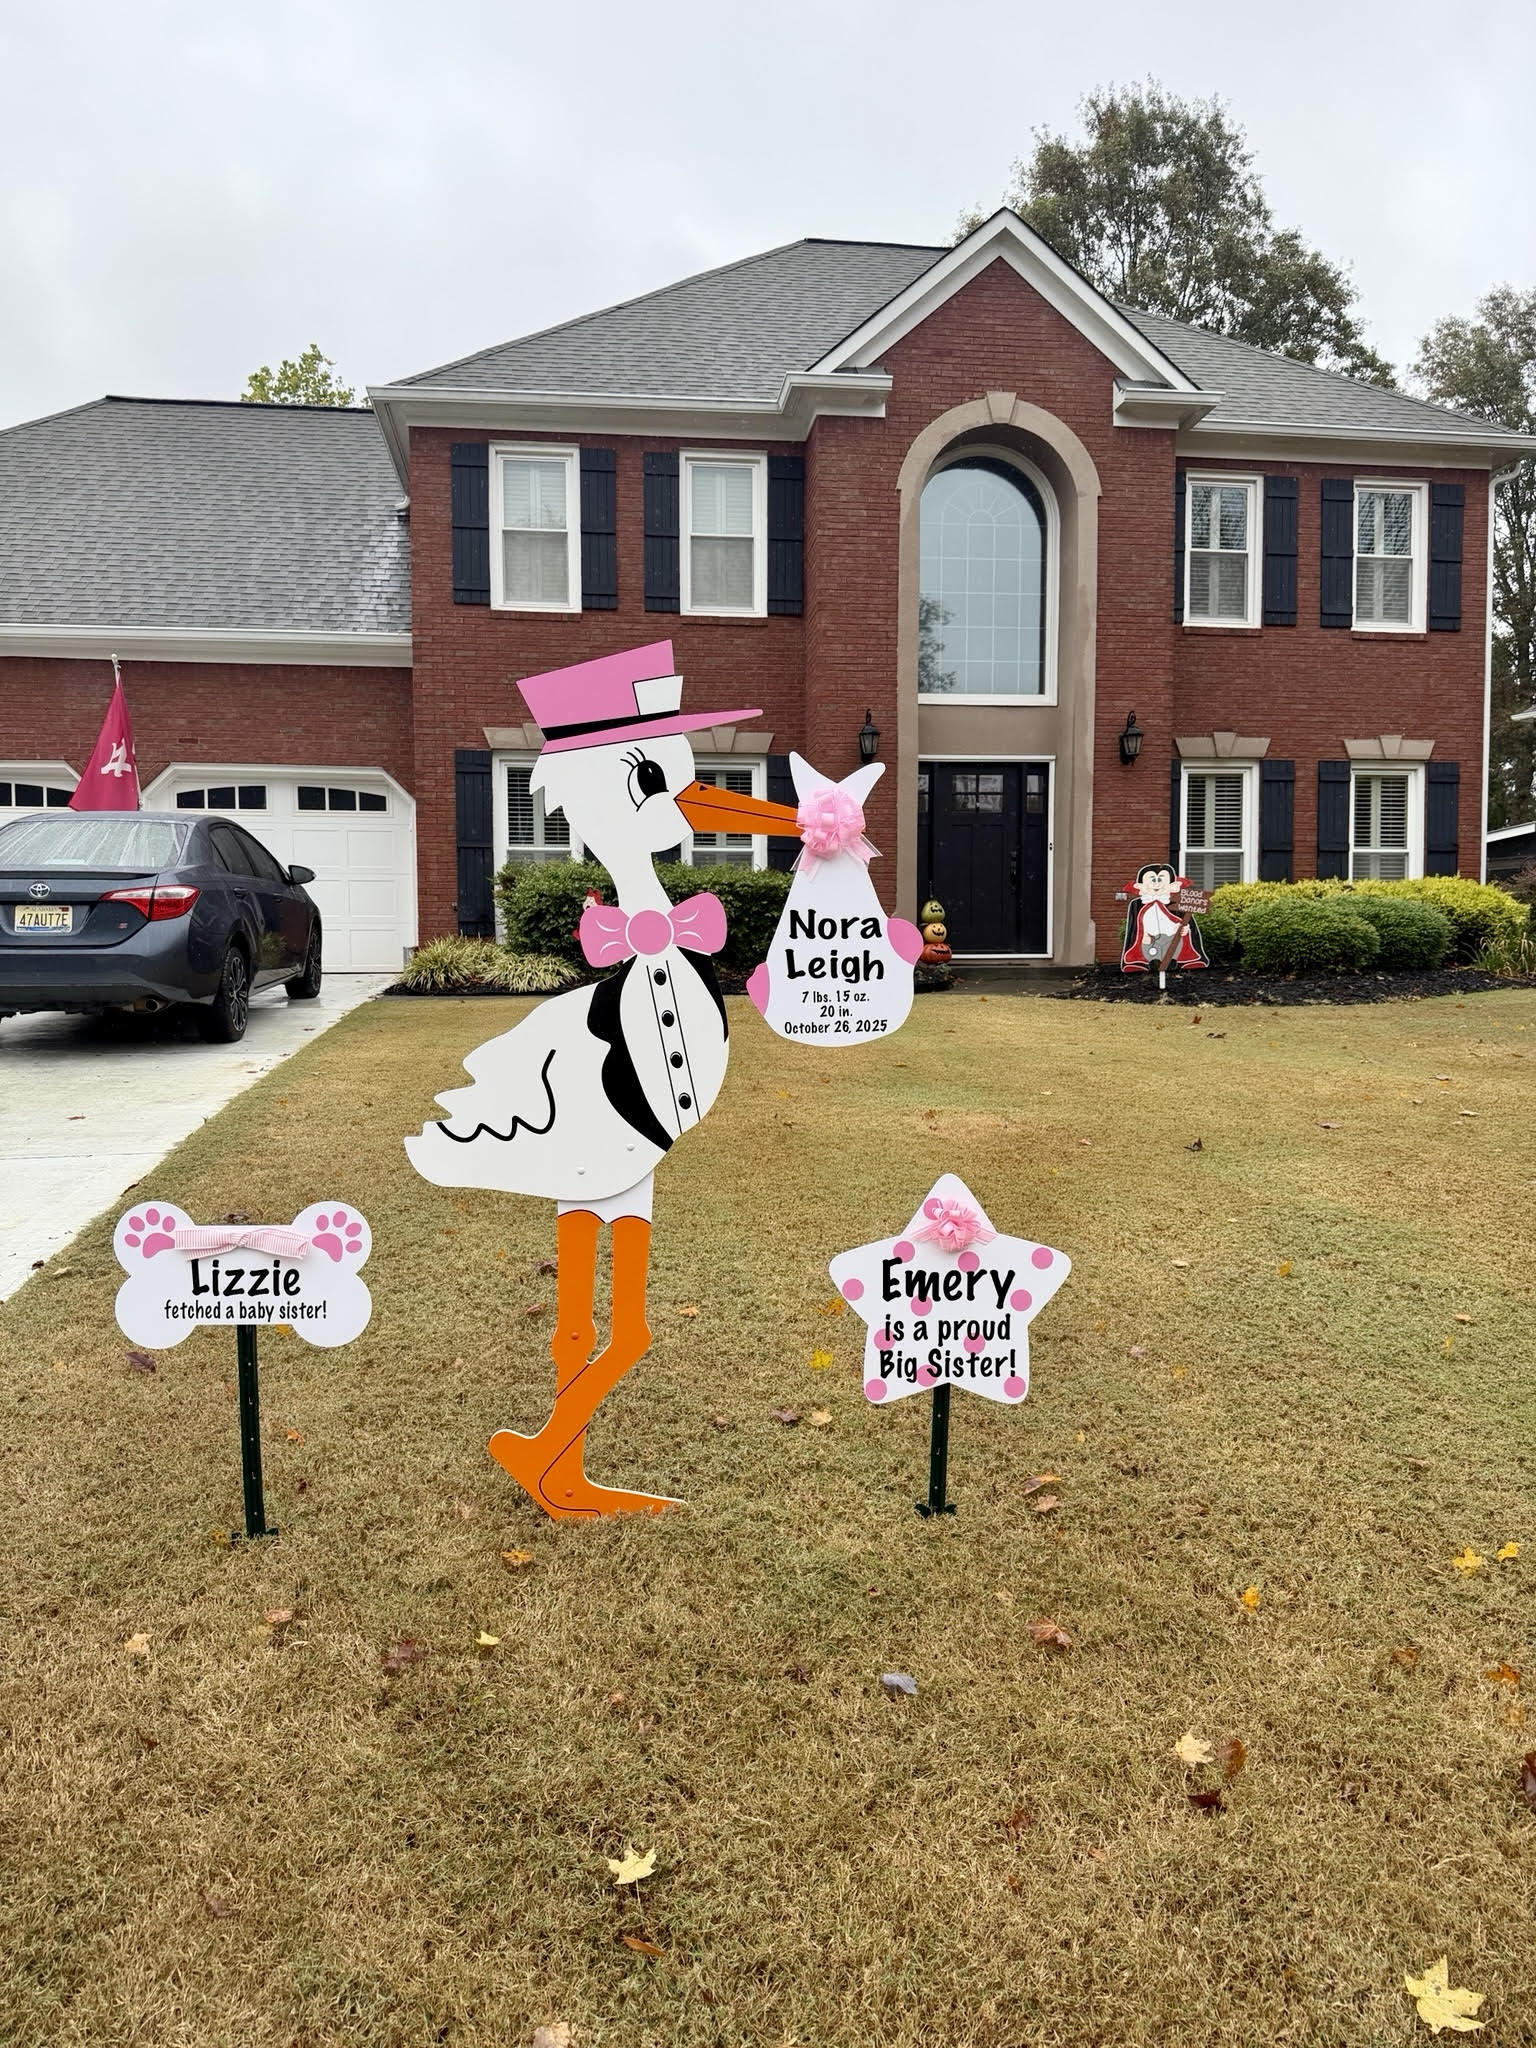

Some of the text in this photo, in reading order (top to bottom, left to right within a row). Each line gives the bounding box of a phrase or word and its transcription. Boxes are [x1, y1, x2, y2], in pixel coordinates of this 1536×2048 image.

[1178, 904, 1207, 914] Wanted
[1180, 896, 1208, 905] Donors
[19, 913, 69, 927] 47AUT7E
[789, 908, 883, 940] Nora
[784, 948, 885, 984] Leigh
[802, 990, 870, 1004] 7 lbs. 15 oz.
[820, 1005, 853, 1018] 20 in.
[784, 1019, 888, 1034] October 26, 2025
[190, 1259, 301, 1296] Lizzie
[882, 1257, 1016, 1310] Emery
[164, 1300, 327, 1322] fetched a baby sister!
[884, 1313, 1011, 1347] is a proud
[879, 1348, 1016, 1384] Big Sister!
